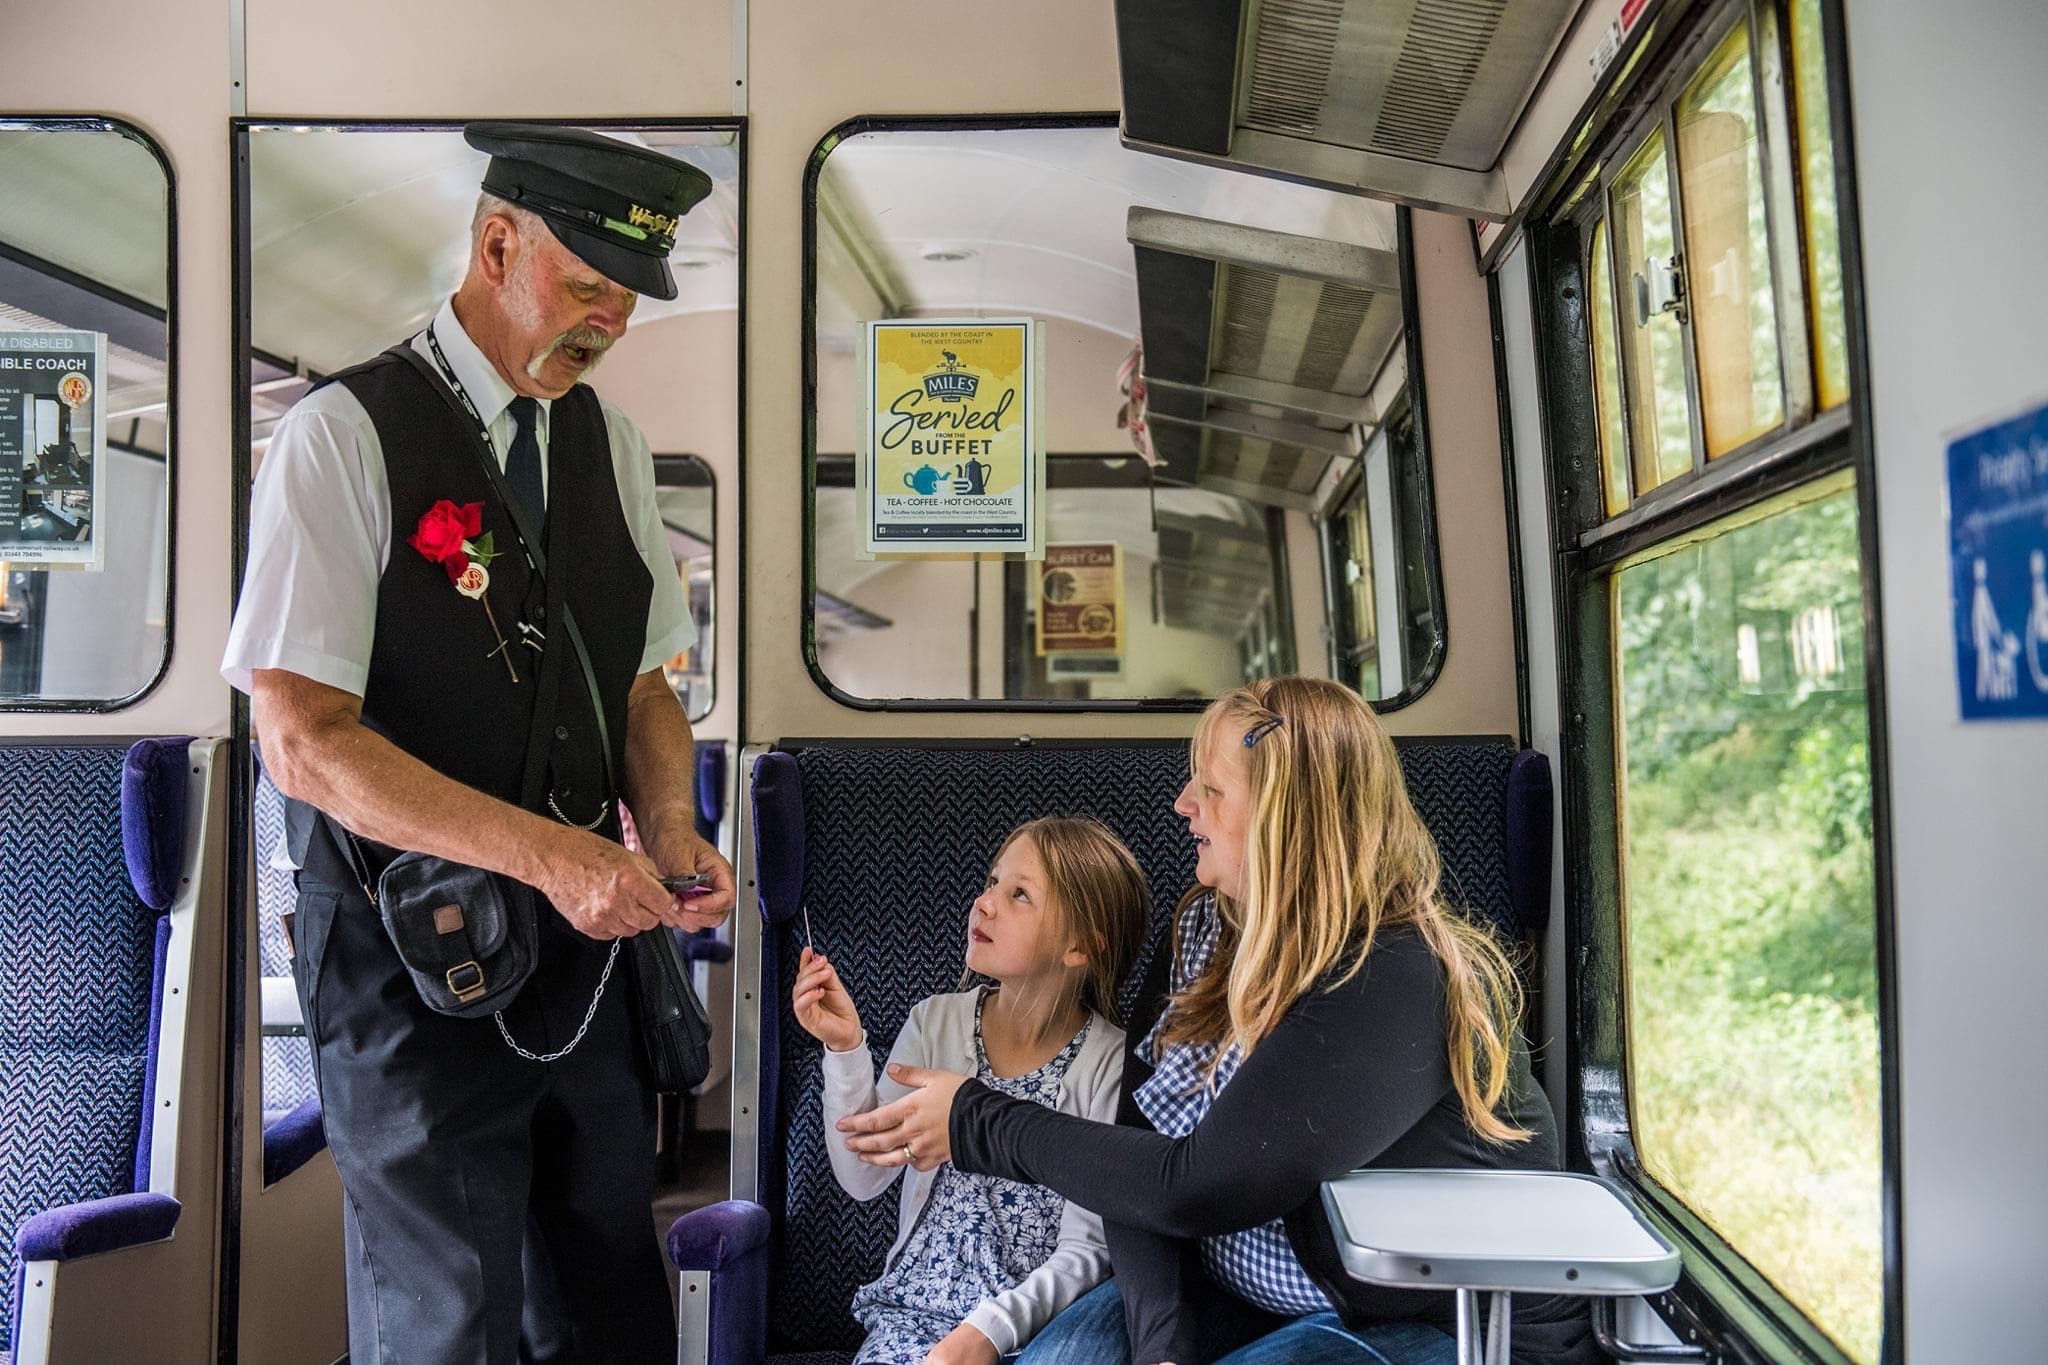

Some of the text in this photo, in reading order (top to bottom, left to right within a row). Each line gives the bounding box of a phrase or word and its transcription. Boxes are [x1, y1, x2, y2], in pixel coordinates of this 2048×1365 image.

[9, 337, 74, 349] DISABLED
[36, 358, 87, 371] COACH
[928, 375, 977, 393] MILES
[881, 388, 1015, 450] Served
[911, 439, 993, 456] BUFFET
[887, 498, 1014, 506] TEA COFFEE HOT CHOCOLATE
